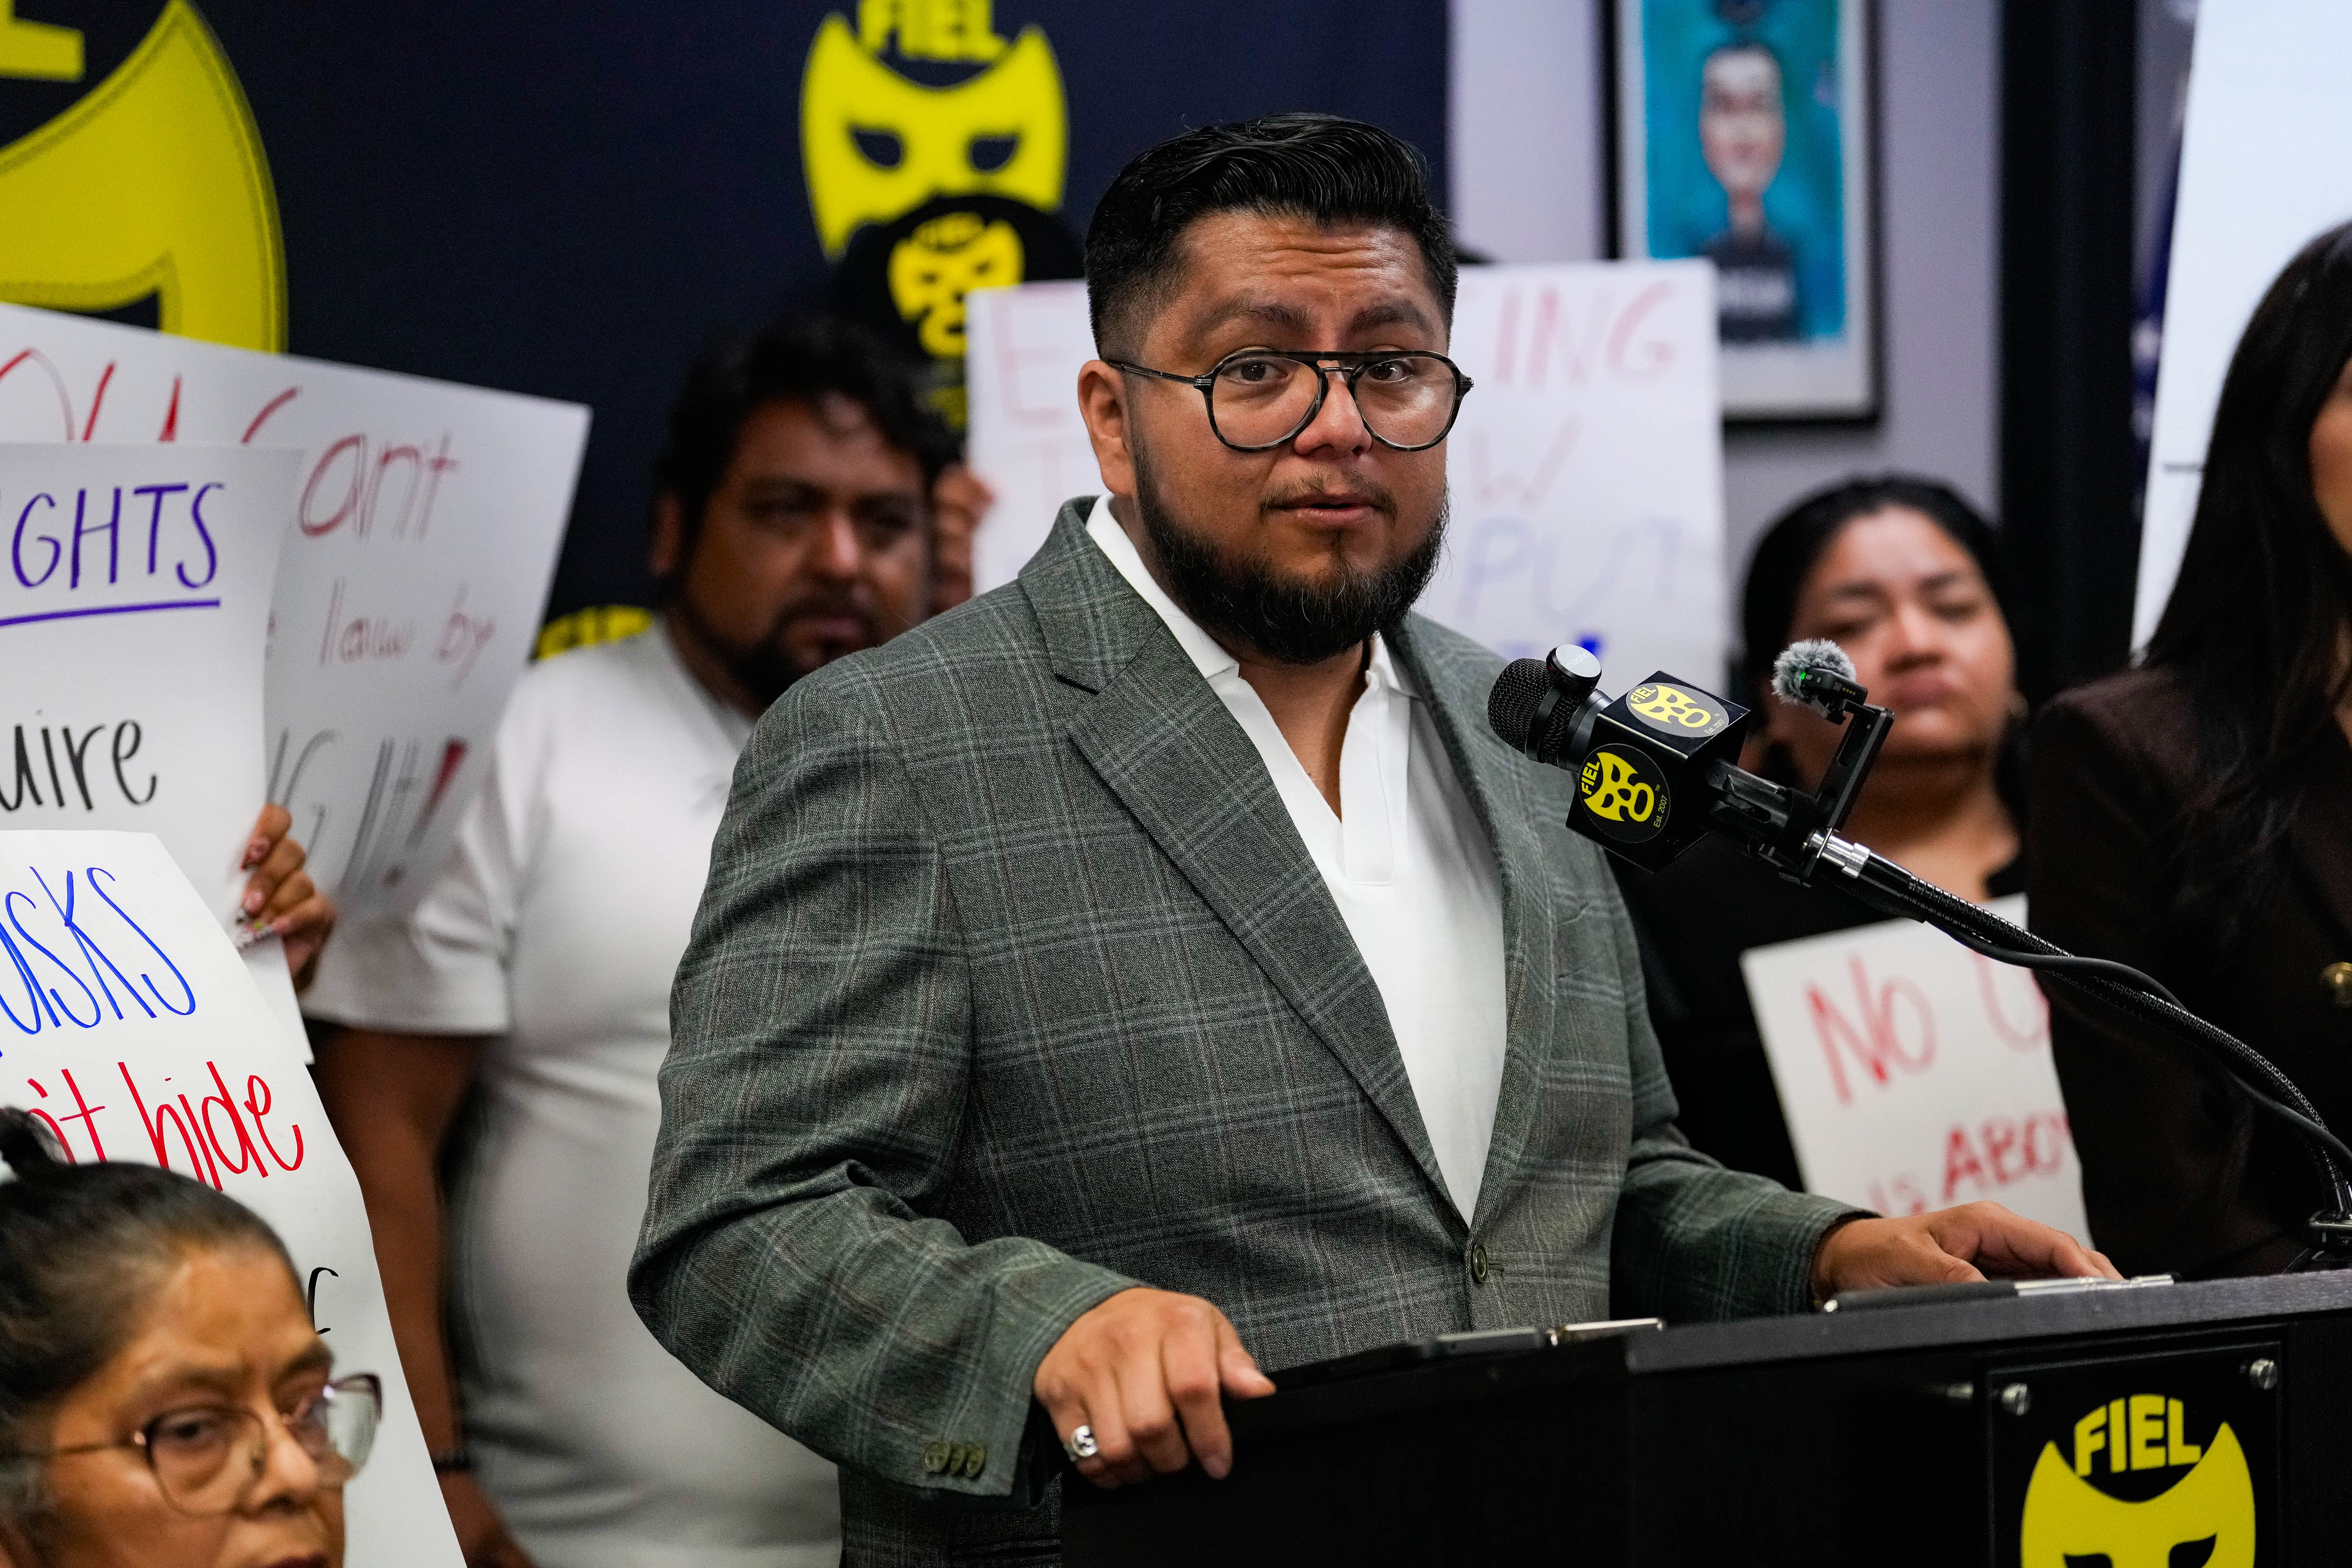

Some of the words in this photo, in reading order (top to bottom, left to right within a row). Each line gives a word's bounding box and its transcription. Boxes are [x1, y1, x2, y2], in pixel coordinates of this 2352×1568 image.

[1566, 652, 1590, 670] maono
[1630, 687, 1657, 704] FIEL
[1712, 719, 1725, 729] 2007
[1581, 761, 1600, 795] FIEL
[1658, 795, 1668, 814] 2007
[117, 1061, 304, 1192] hide
[1942, 1112, 2071, 1203] ABO
[2074, 1393, 2202, 1478] FIEL
